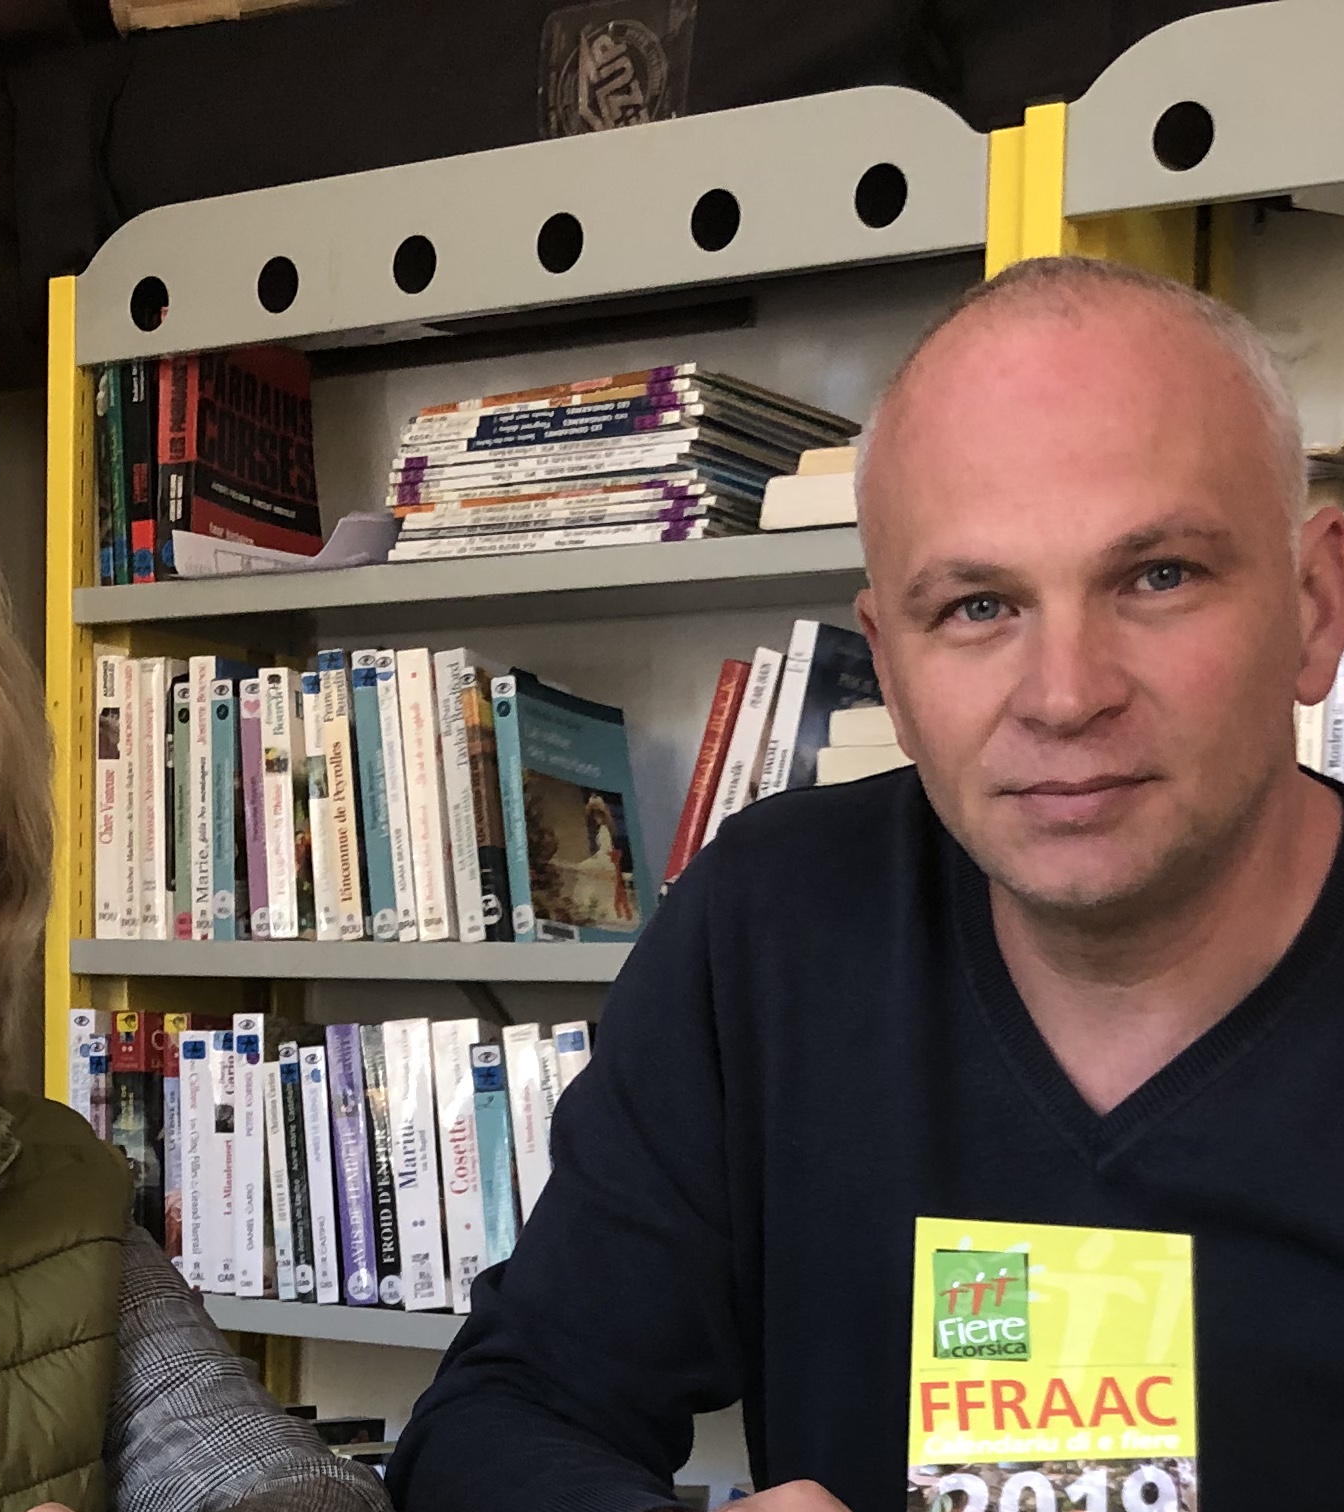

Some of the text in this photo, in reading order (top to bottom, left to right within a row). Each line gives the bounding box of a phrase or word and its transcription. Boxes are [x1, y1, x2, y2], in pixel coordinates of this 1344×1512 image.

[351, 1229, 366, 1265] AVIS
[378, 1208, 395, 1264] FROID
[939, 1316, 1026, 1350] Fiere
[950, 1341, 1028, 1358] corsica
[920, 1375, 1177, 1432] FFRAAC
[1119, 1431, 1181, 1451] fiere
